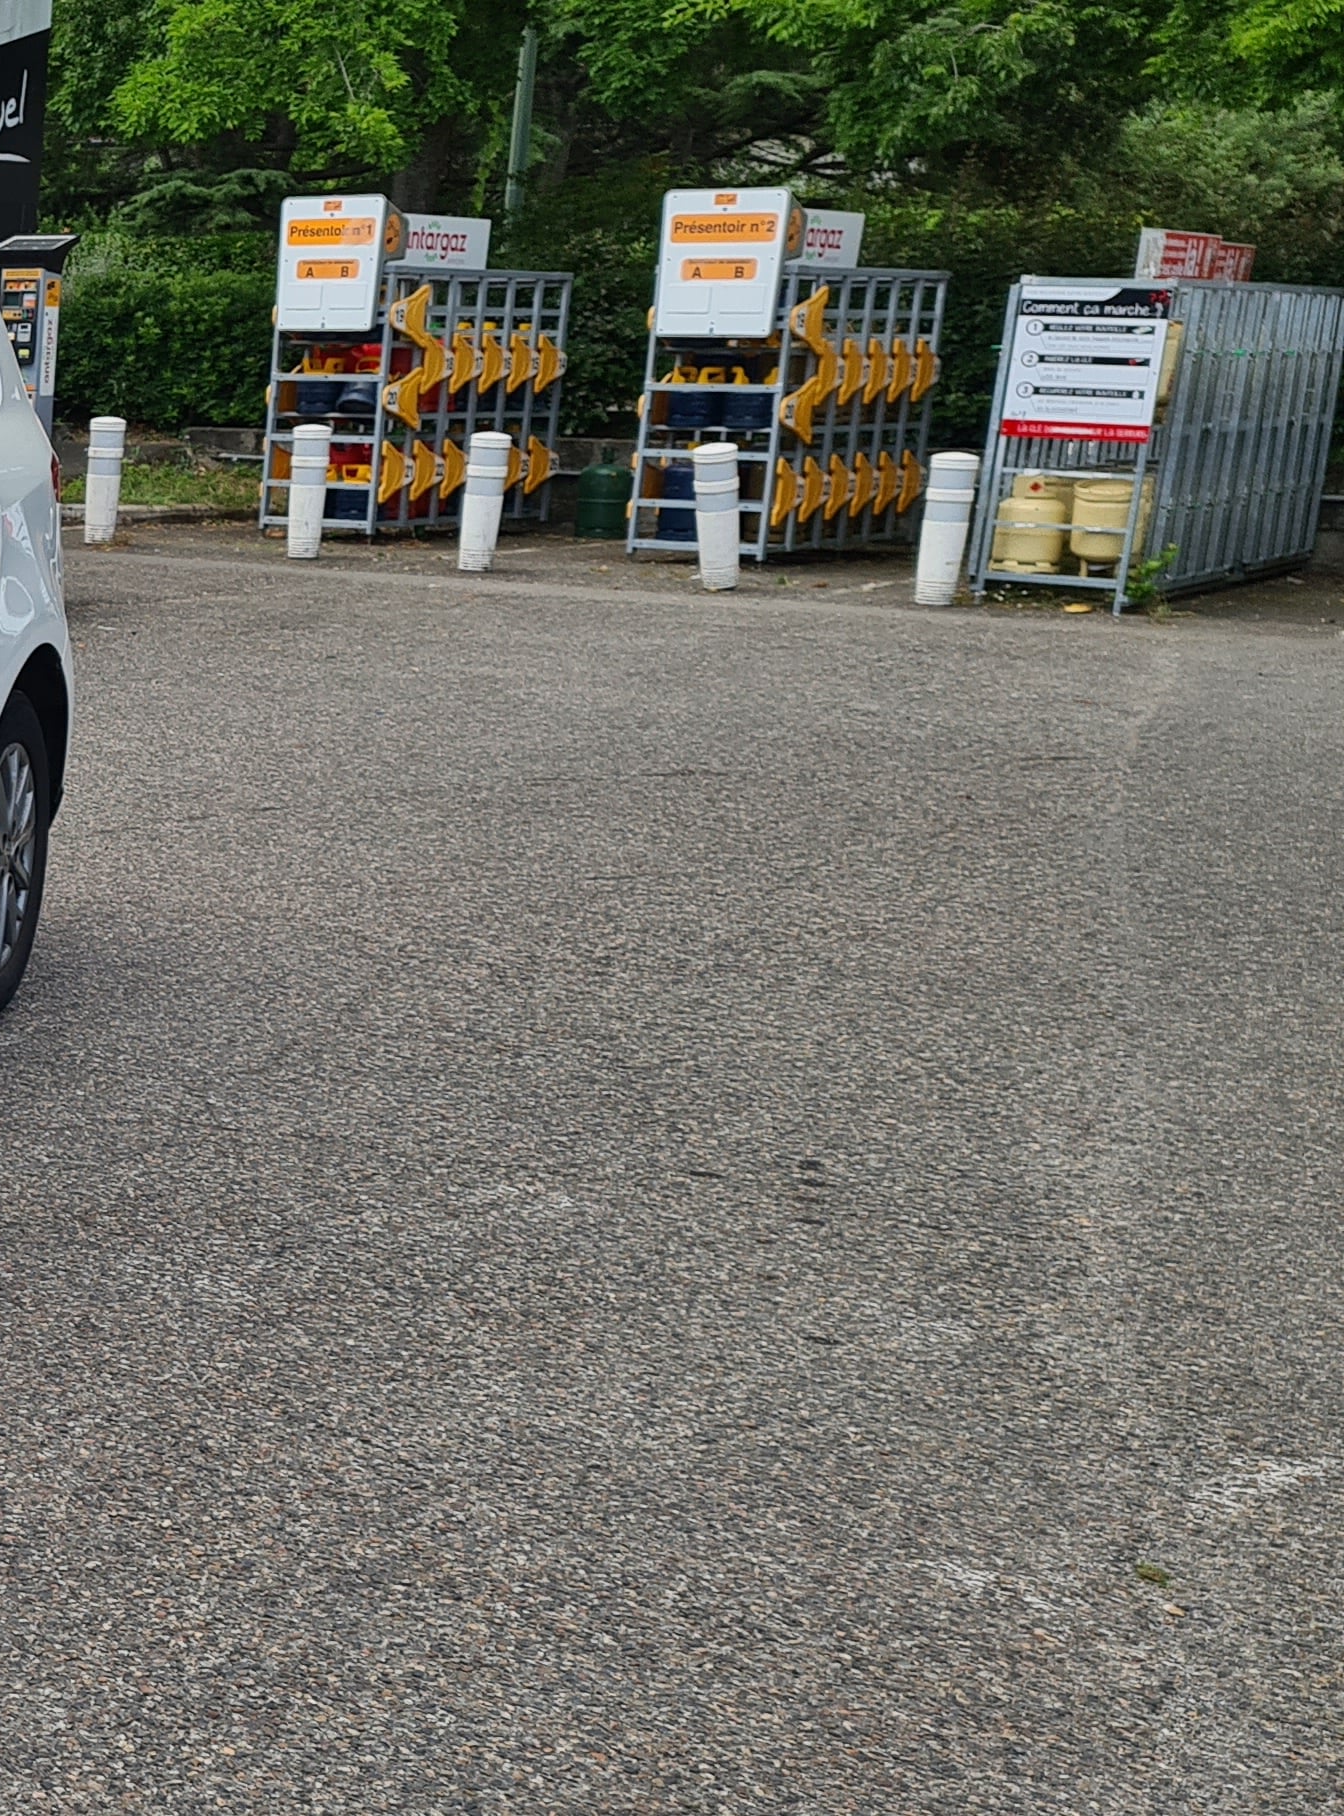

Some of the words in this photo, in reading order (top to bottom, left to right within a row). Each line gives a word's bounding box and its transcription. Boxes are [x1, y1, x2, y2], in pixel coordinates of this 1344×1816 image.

[290, 222, 348, 238] Présentoir
[674, 220, 746, 234] Présentoir
[750, 220, 776, 233] n°2
[305, 267, 314, 278] A
[340, 266, 349, 278] B
[691, 267, 702, 279] A
[734, 266, 745, 279] B
[1023, 301, 1079, 315] Comment
